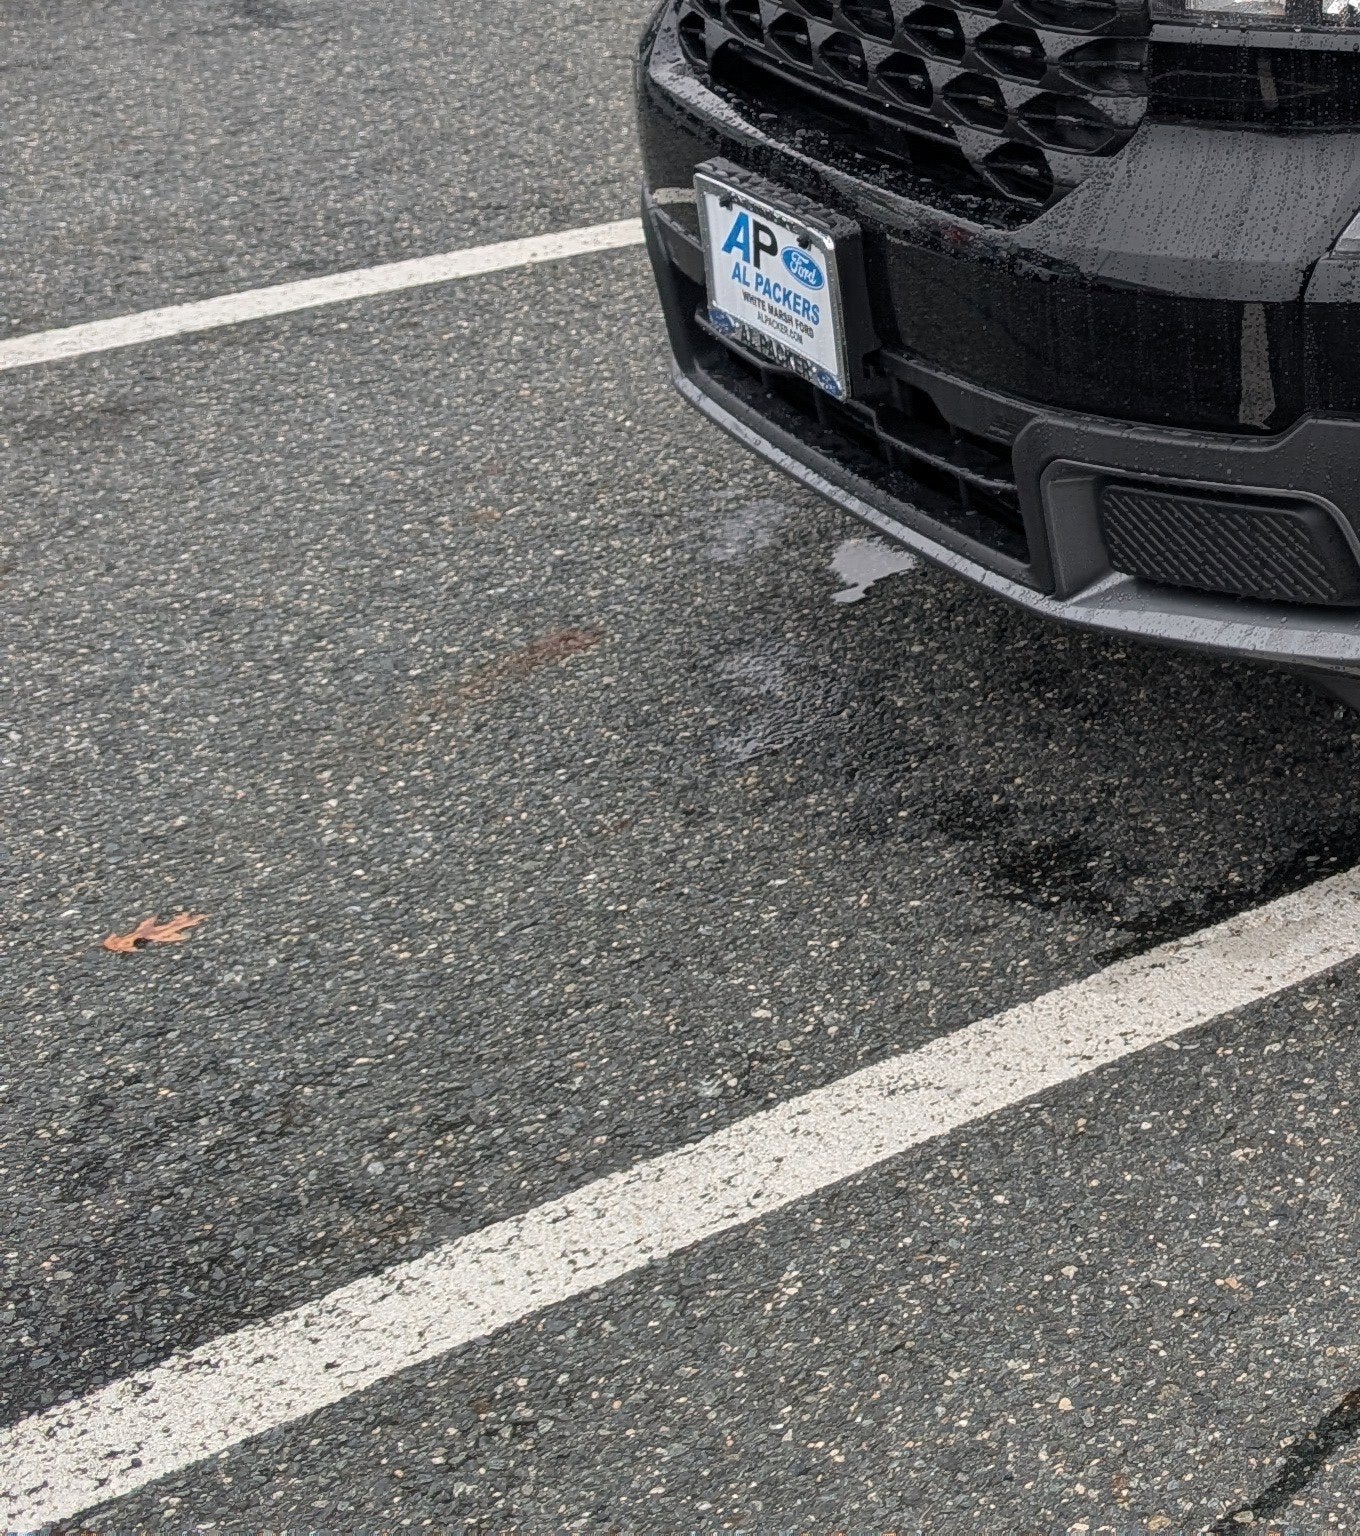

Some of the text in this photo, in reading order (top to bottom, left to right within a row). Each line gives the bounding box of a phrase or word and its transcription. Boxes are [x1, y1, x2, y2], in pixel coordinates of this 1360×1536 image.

[722, 211, 779, 270] AP
[731, 262, 750, 288] AL
[754, 272, 821, 326] PACKERS
[788, 252, 817, 286] Ford
[742, 289, 767, 313] WHITE
[795, 319, 815, 339] FORD
